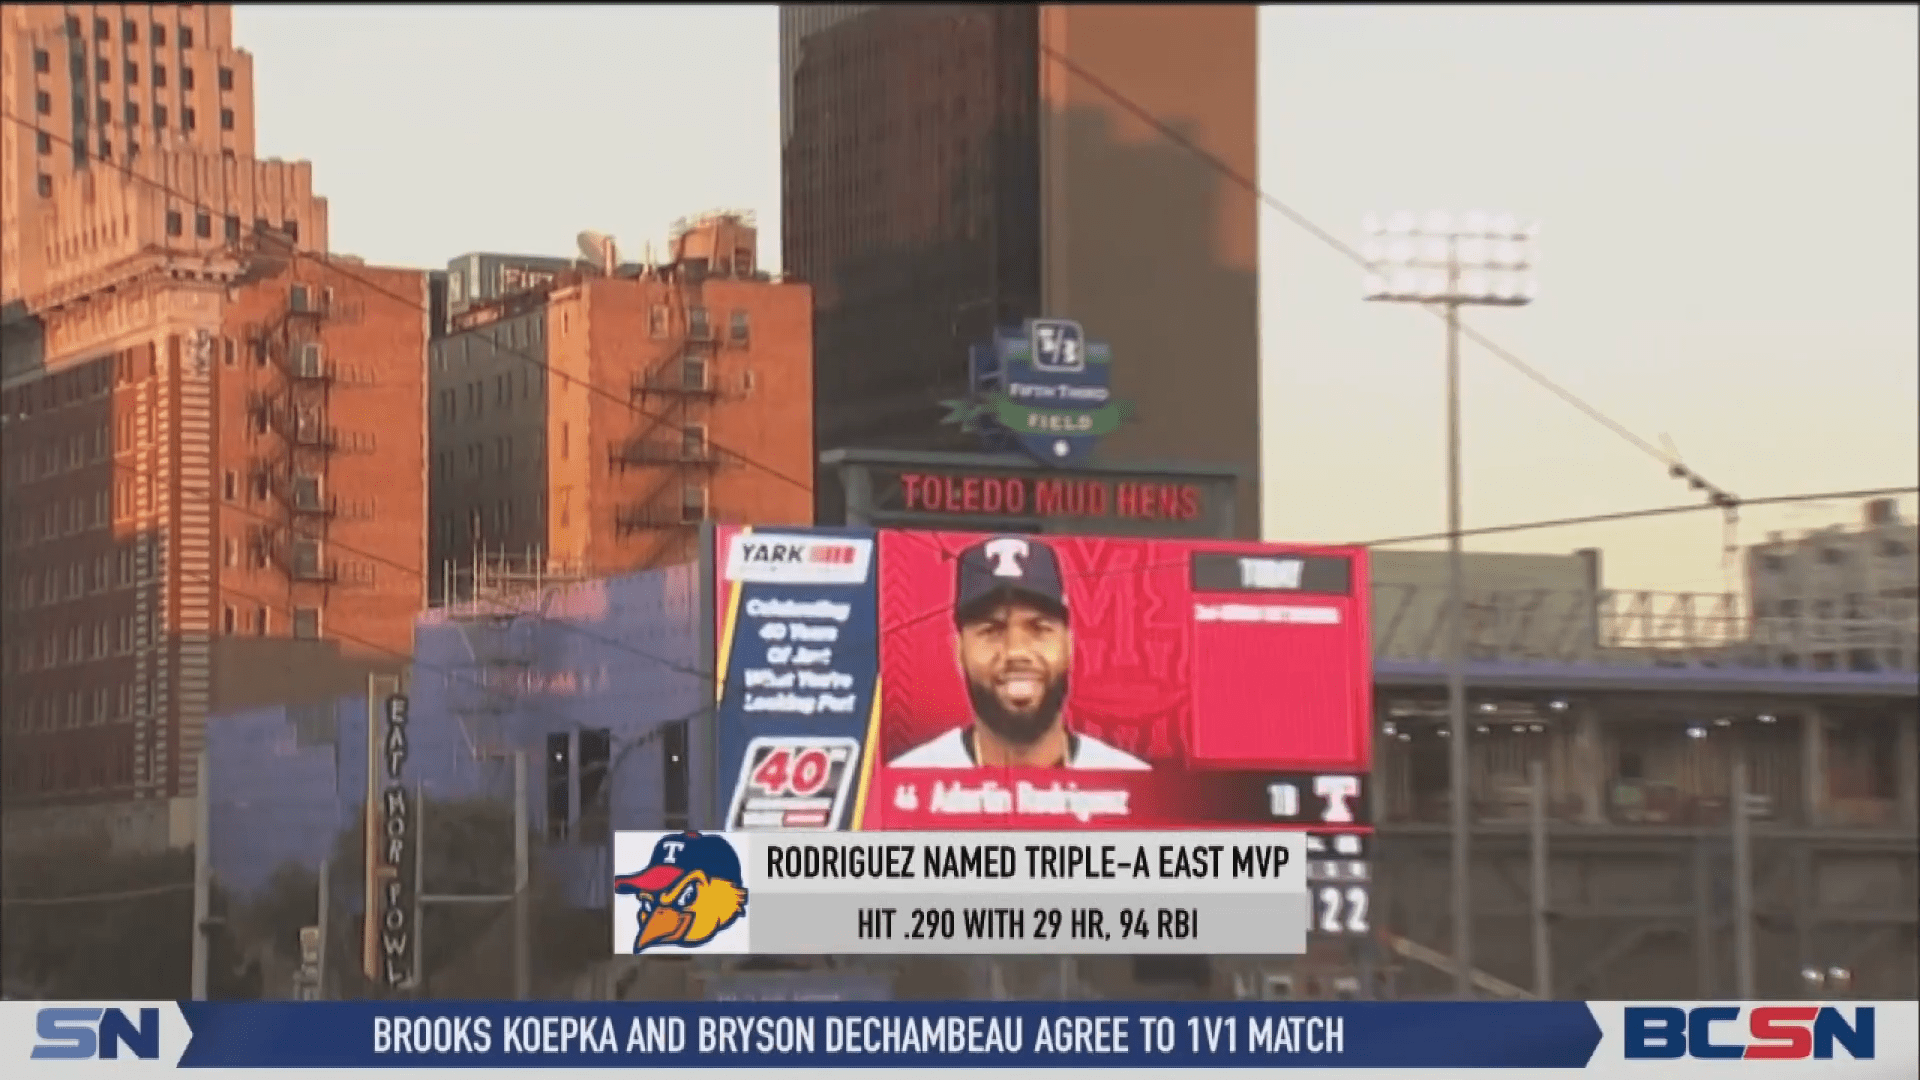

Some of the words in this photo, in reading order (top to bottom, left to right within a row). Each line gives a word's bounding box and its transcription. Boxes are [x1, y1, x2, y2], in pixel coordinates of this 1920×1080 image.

[1027, 411, 1094, 431] FIELD
[901, 473, 1025, 513] TOLEDO
[1034, 478, 1109, 518] MUD
[1116, 482, 1201, 521] HENS
[741, 543, 806, 564] YARK
[384, 697, 409, 783] EAT
[753, 747, 831, 796] 40
